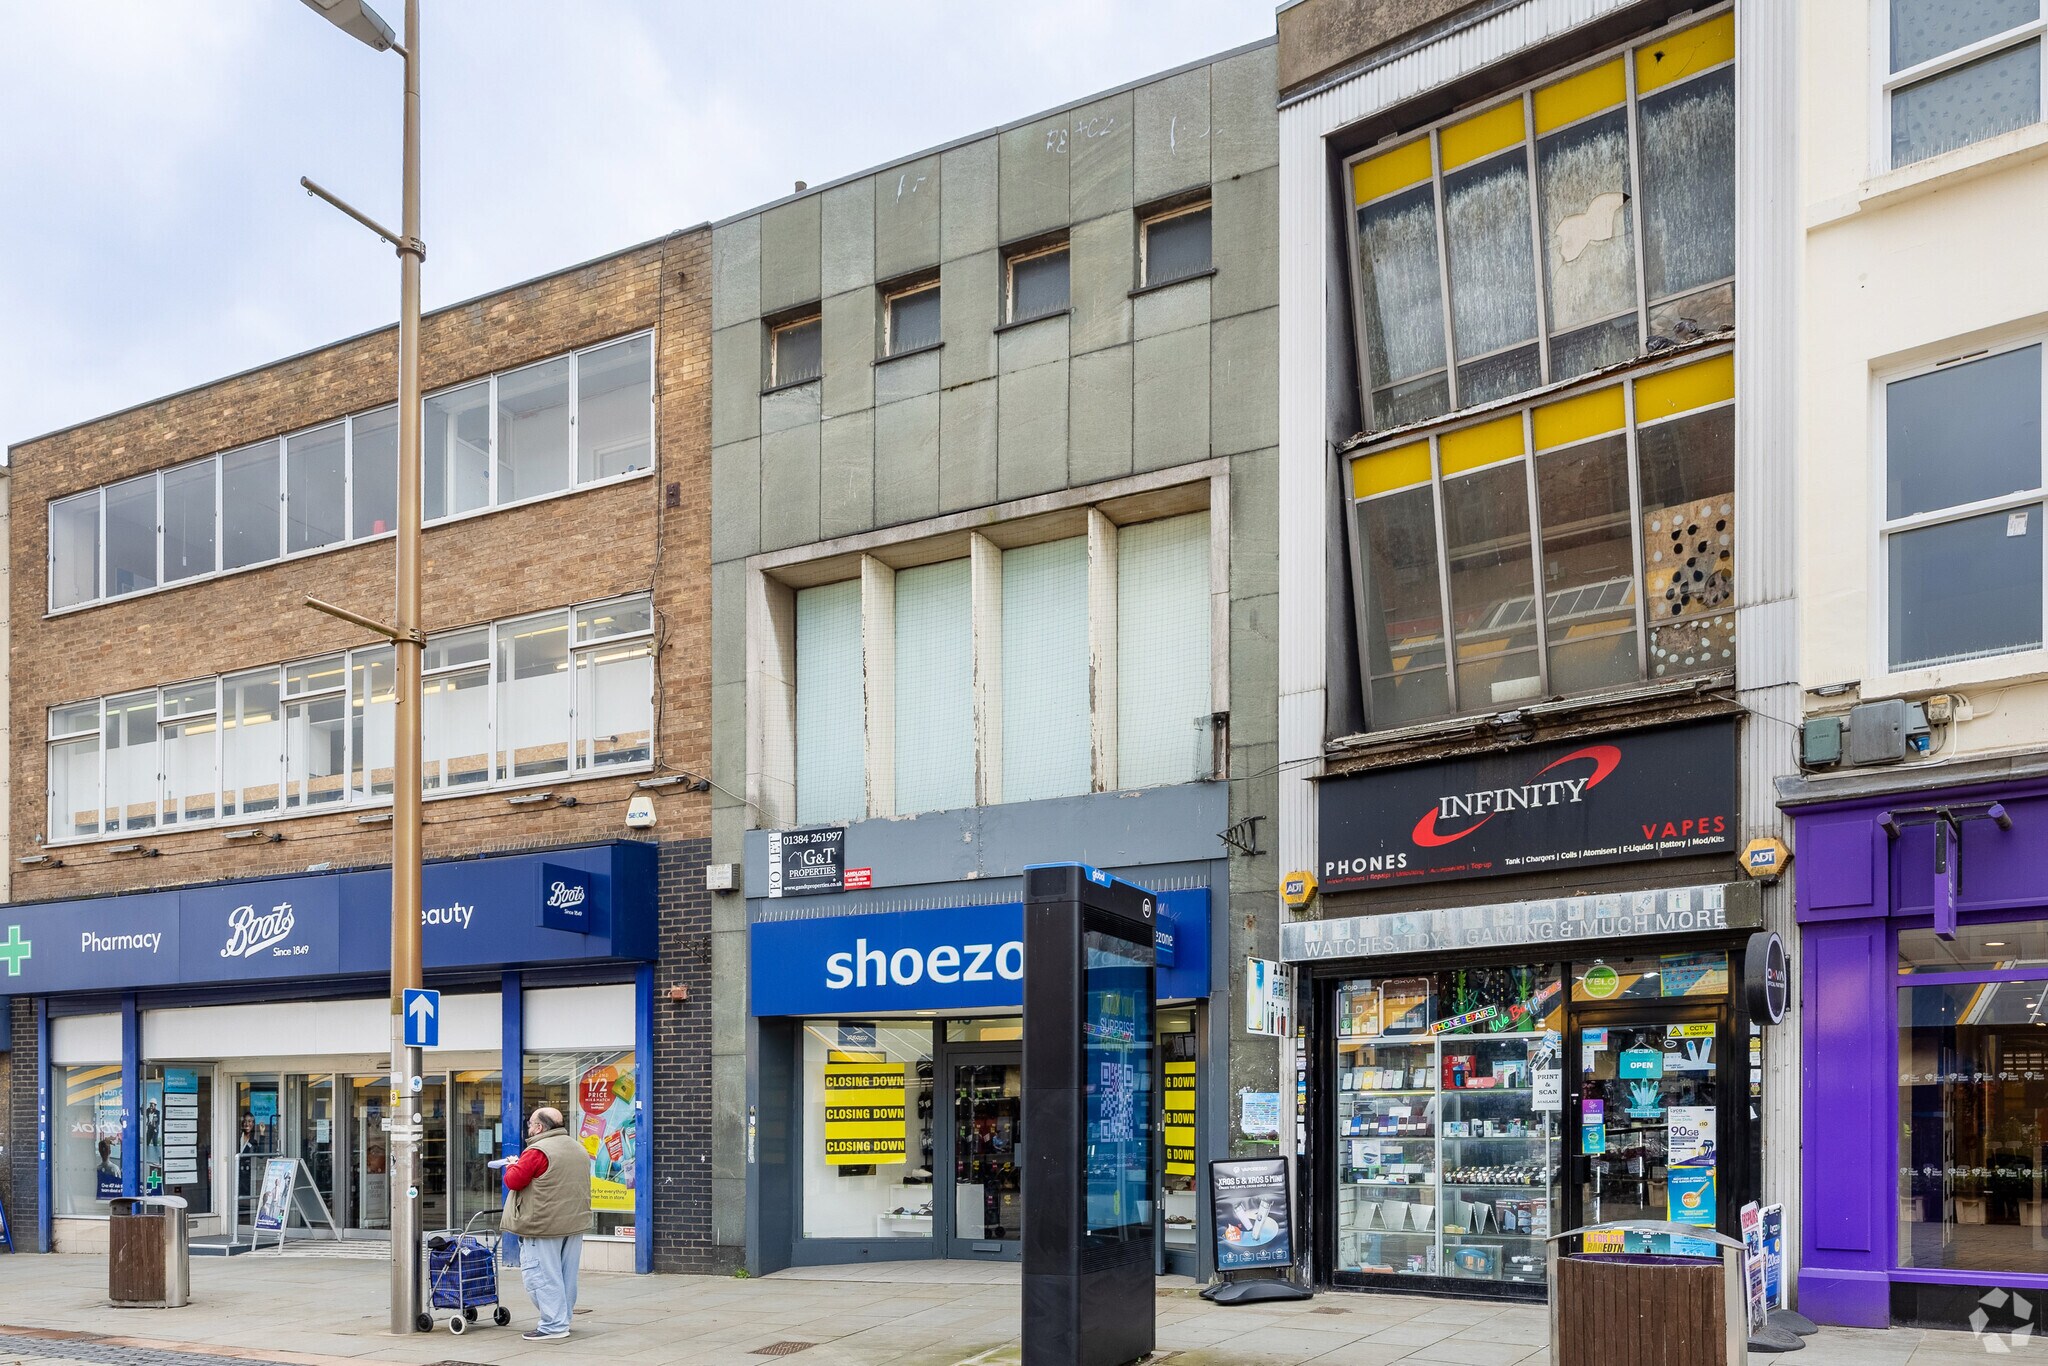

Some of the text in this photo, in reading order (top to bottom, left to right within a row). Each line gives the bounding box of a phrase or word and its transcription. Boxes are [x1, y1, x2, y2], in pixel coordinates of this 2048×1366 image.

[1438, 777, 1589, 820] INFINITY
[1642, 815, 1726, 840] VAPES
[783, 831, 842, 846] 01384 261997
[769, 836, 781, 864] LET
[803, 847, 835, 866] G&T
[1505, 835, 1725, 865] Tank Chargers Coils Atomisers E-Liquids Battery Mod/Kits
[1325, 852, 1407, 877] PHONES
[1751, 851, 1775, 864] ADT
[789, 866, 836, 878] PROPERTIES
[769, 870, 781, 894] TO
[1286, 882, 1304, 894] ADT
[546, 881, 585, 909] Boots
[421, 902, 474, 929] eauty
[220, 901, 295, 958] Boots
[1466, 922, 1554, 946] GAMING
[1559, 921, 1574, 937] &
[1580, 915, 1649, 938] MUCH
[1656, 909, 1726, 931] MORE
[81, 932, 161, 954] Pharmacy
[273, 945, 309, 957] Since 1849
[825, 938, 1024, 990] shoezo
[1342, 984, 1358, 992] dojo
[1586, 977, 1616, 986] VELO
[1432, 1007, 1495, 1034] PHONE REPAIRS
[1489, 1013, 1509, 1032] We
[1584, 1032, 1602, 1040] Local
[1630, 1061, 1654, 1069] OPEN
[588, 1077, 608, 1092] 1/2
[826, 1076, 905, 1087] CLOSING DOWN
[1172, 1077, 1195, 1088] DOWN
[826, 1108, 905, 1120] CLOSING DOWN
[1172, 1112, 1195, 1124] DOWN
[1670, 1126, 1700, 1137] 90GB
[826, 1140, 905, 1152] CLOSING DOWN
[1173, 1149, 1195, 1161] DOWN
[1218, 1178, 1235, 1186] XROS
[1241, 1177, 1247, 1185] &
[1248, 1175, 1264, 1185] XROS
[1264, 1175, 1270, 1183] 5
[1269, 1174, 1283, 1183] MINI
[1593, 1234, 1608, 1243] FOR
